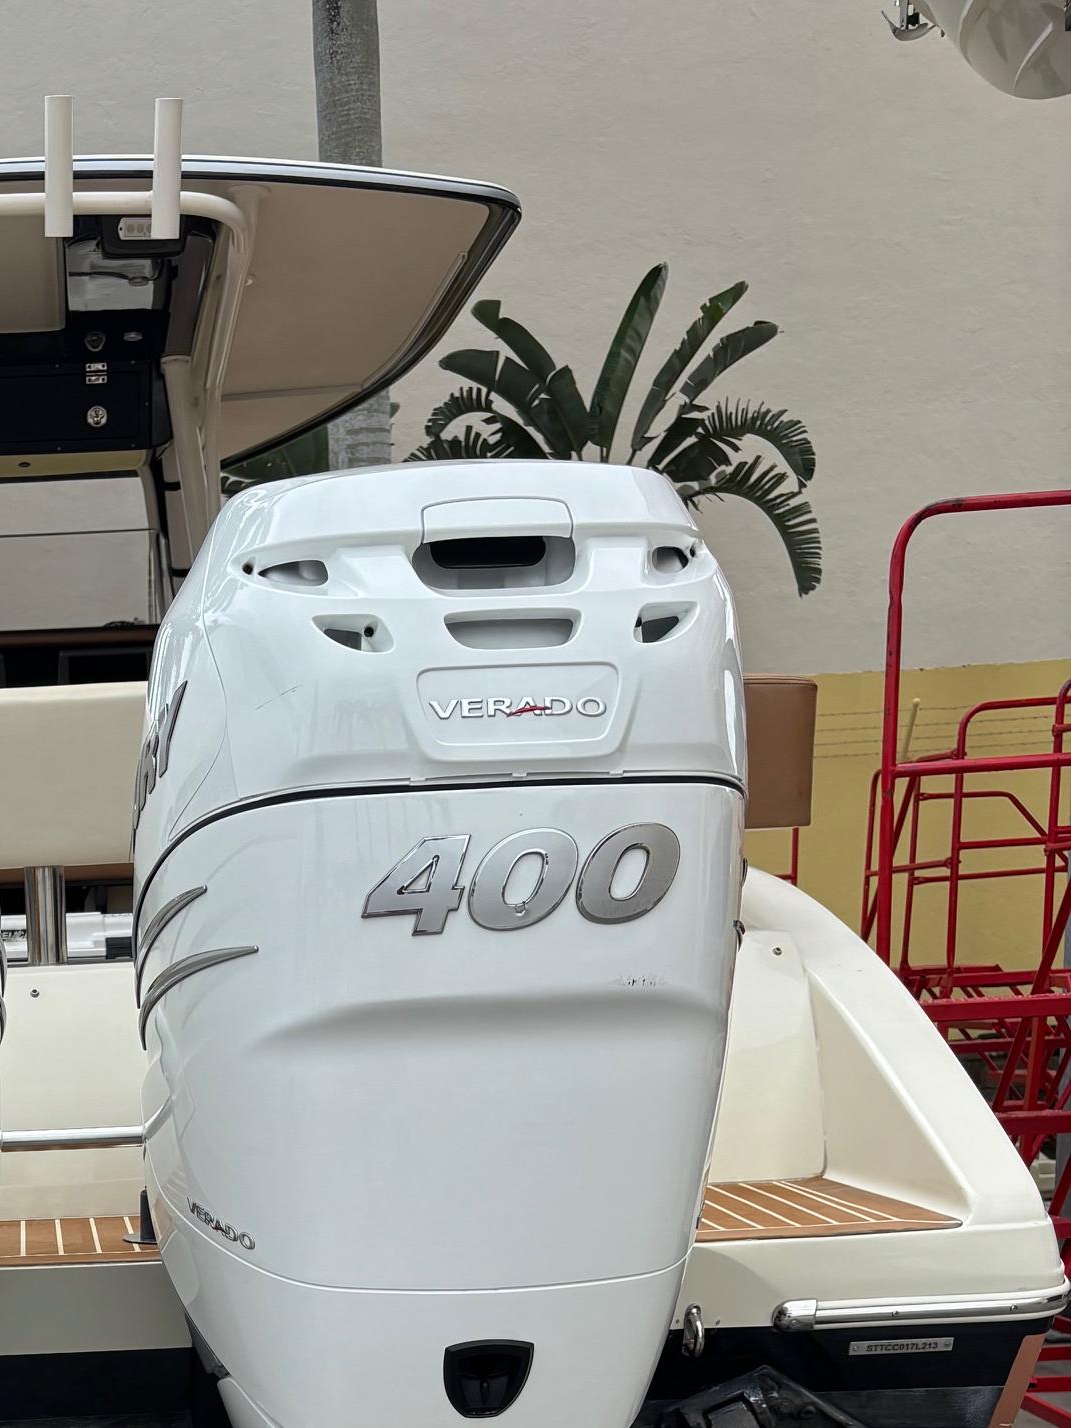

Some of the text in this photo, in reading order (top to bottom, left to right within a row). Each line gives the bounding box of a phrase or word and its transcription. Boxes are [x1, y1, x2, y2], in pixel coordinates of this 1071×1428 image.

[430, 696, 606, 719] VERADO
[362, 823, 680, 936] 400
[186, 1196, 255, 1250] VERADO
